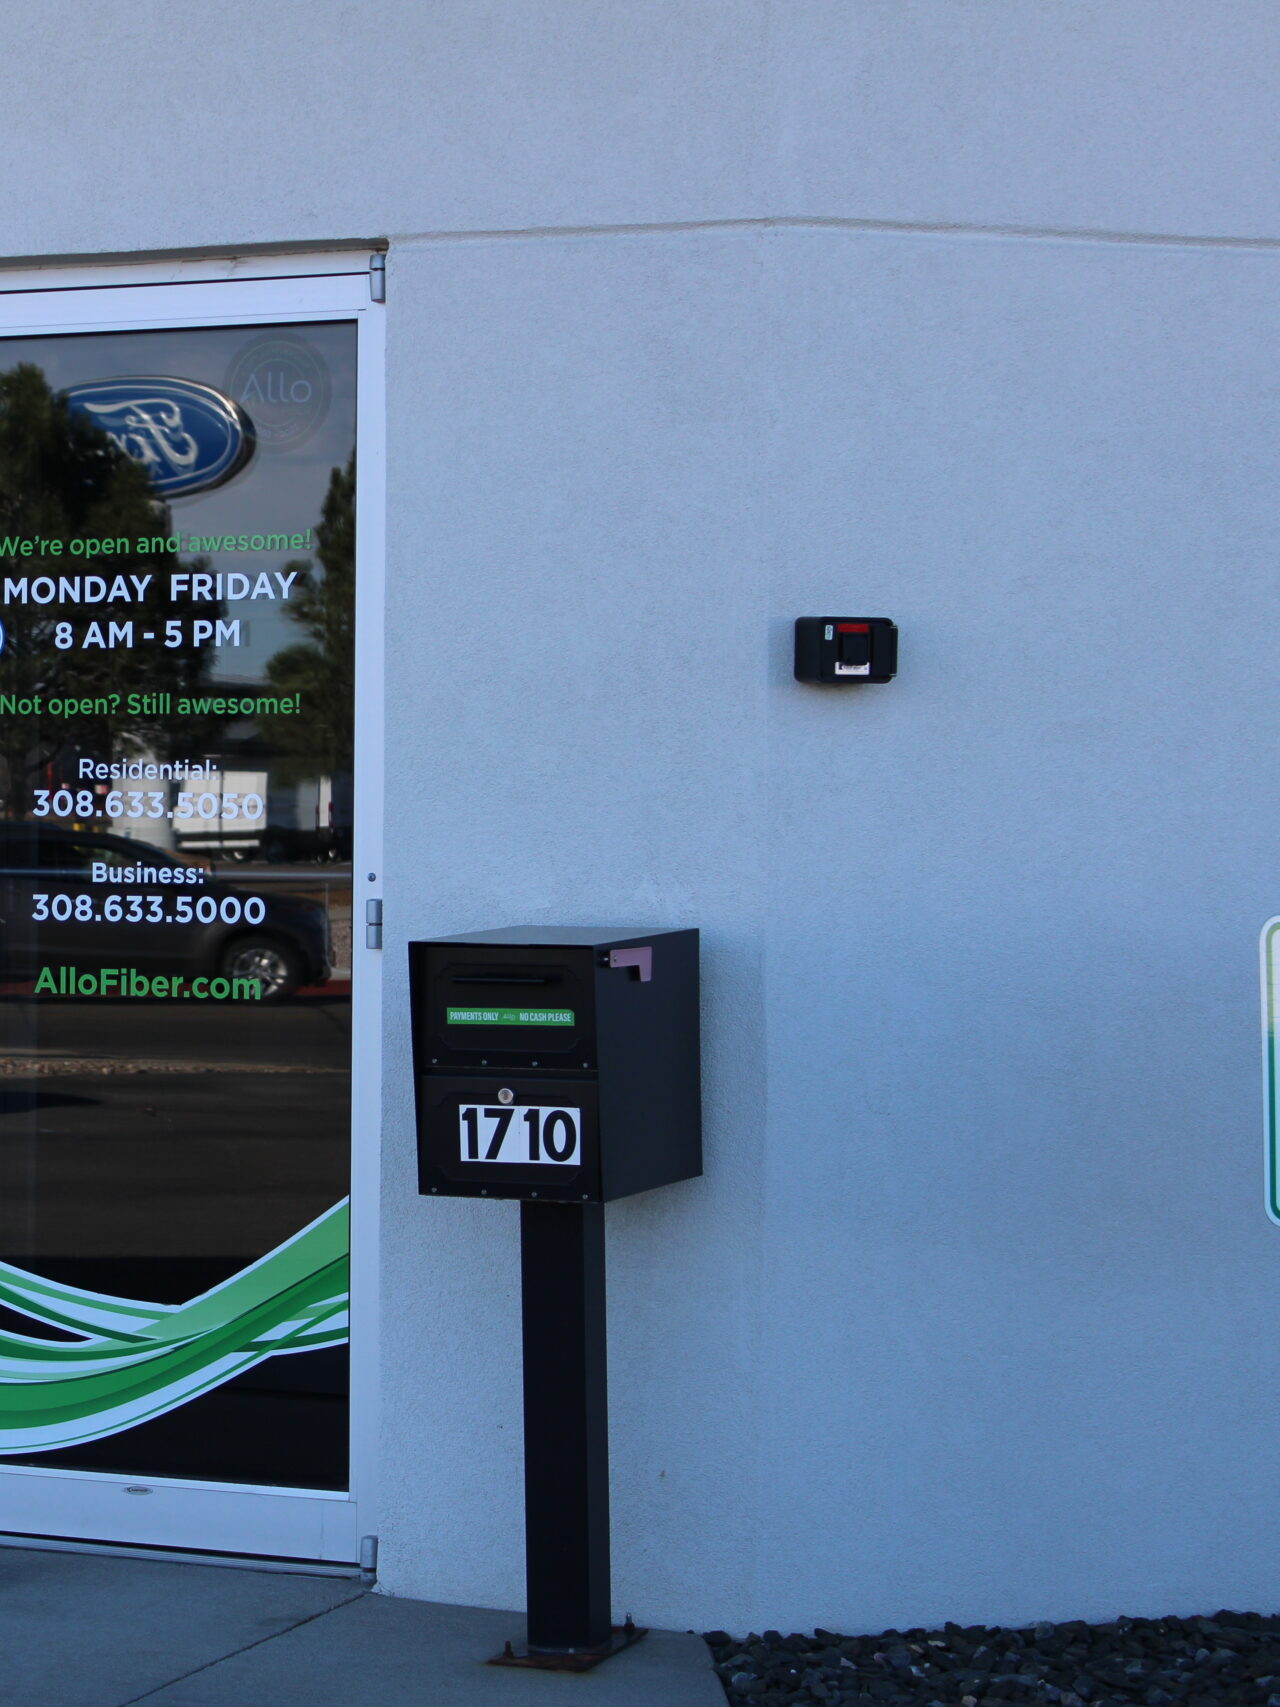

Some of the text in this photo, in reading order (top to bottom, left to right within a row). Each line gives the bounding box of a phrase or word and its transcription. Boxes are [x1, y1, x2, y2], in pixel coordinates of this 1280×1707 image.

[239, 371, 312, 403] Allo
[70, 536, 130, 558] open
[137, 532, 181, 553] and
[188, 528, 312, 552] awesome!
[4, 571, 298, 604] MONDAY FRIDAY
[55, 622, 73, 649] 8
[82, 621, 132, 648] AM
[165, 620, 182, 647] 5
[194, 619, 241, 647] PM
[0, 693, 301, 718] Not open? Still awesome!
[79, 758, 218, 781] Residential:
[33, 789, 265, 821] 308.633.5050
[92, 861, 204, 884] Business:
[31, 893, 266, 925] 308.633.5000
[34, 966, 262, 1000] AlloFiber.com
[450, 1011, 482, 1021] PAYMENTS
[482, 1011, 499, 1021] ONLY
[519, 1012, 529, 1022] NO
[529, 1012, 547, 1022] CASH
[548, 1012, 571, 1022] PLEASE
[461, 1107, 577, 1162] 1710
